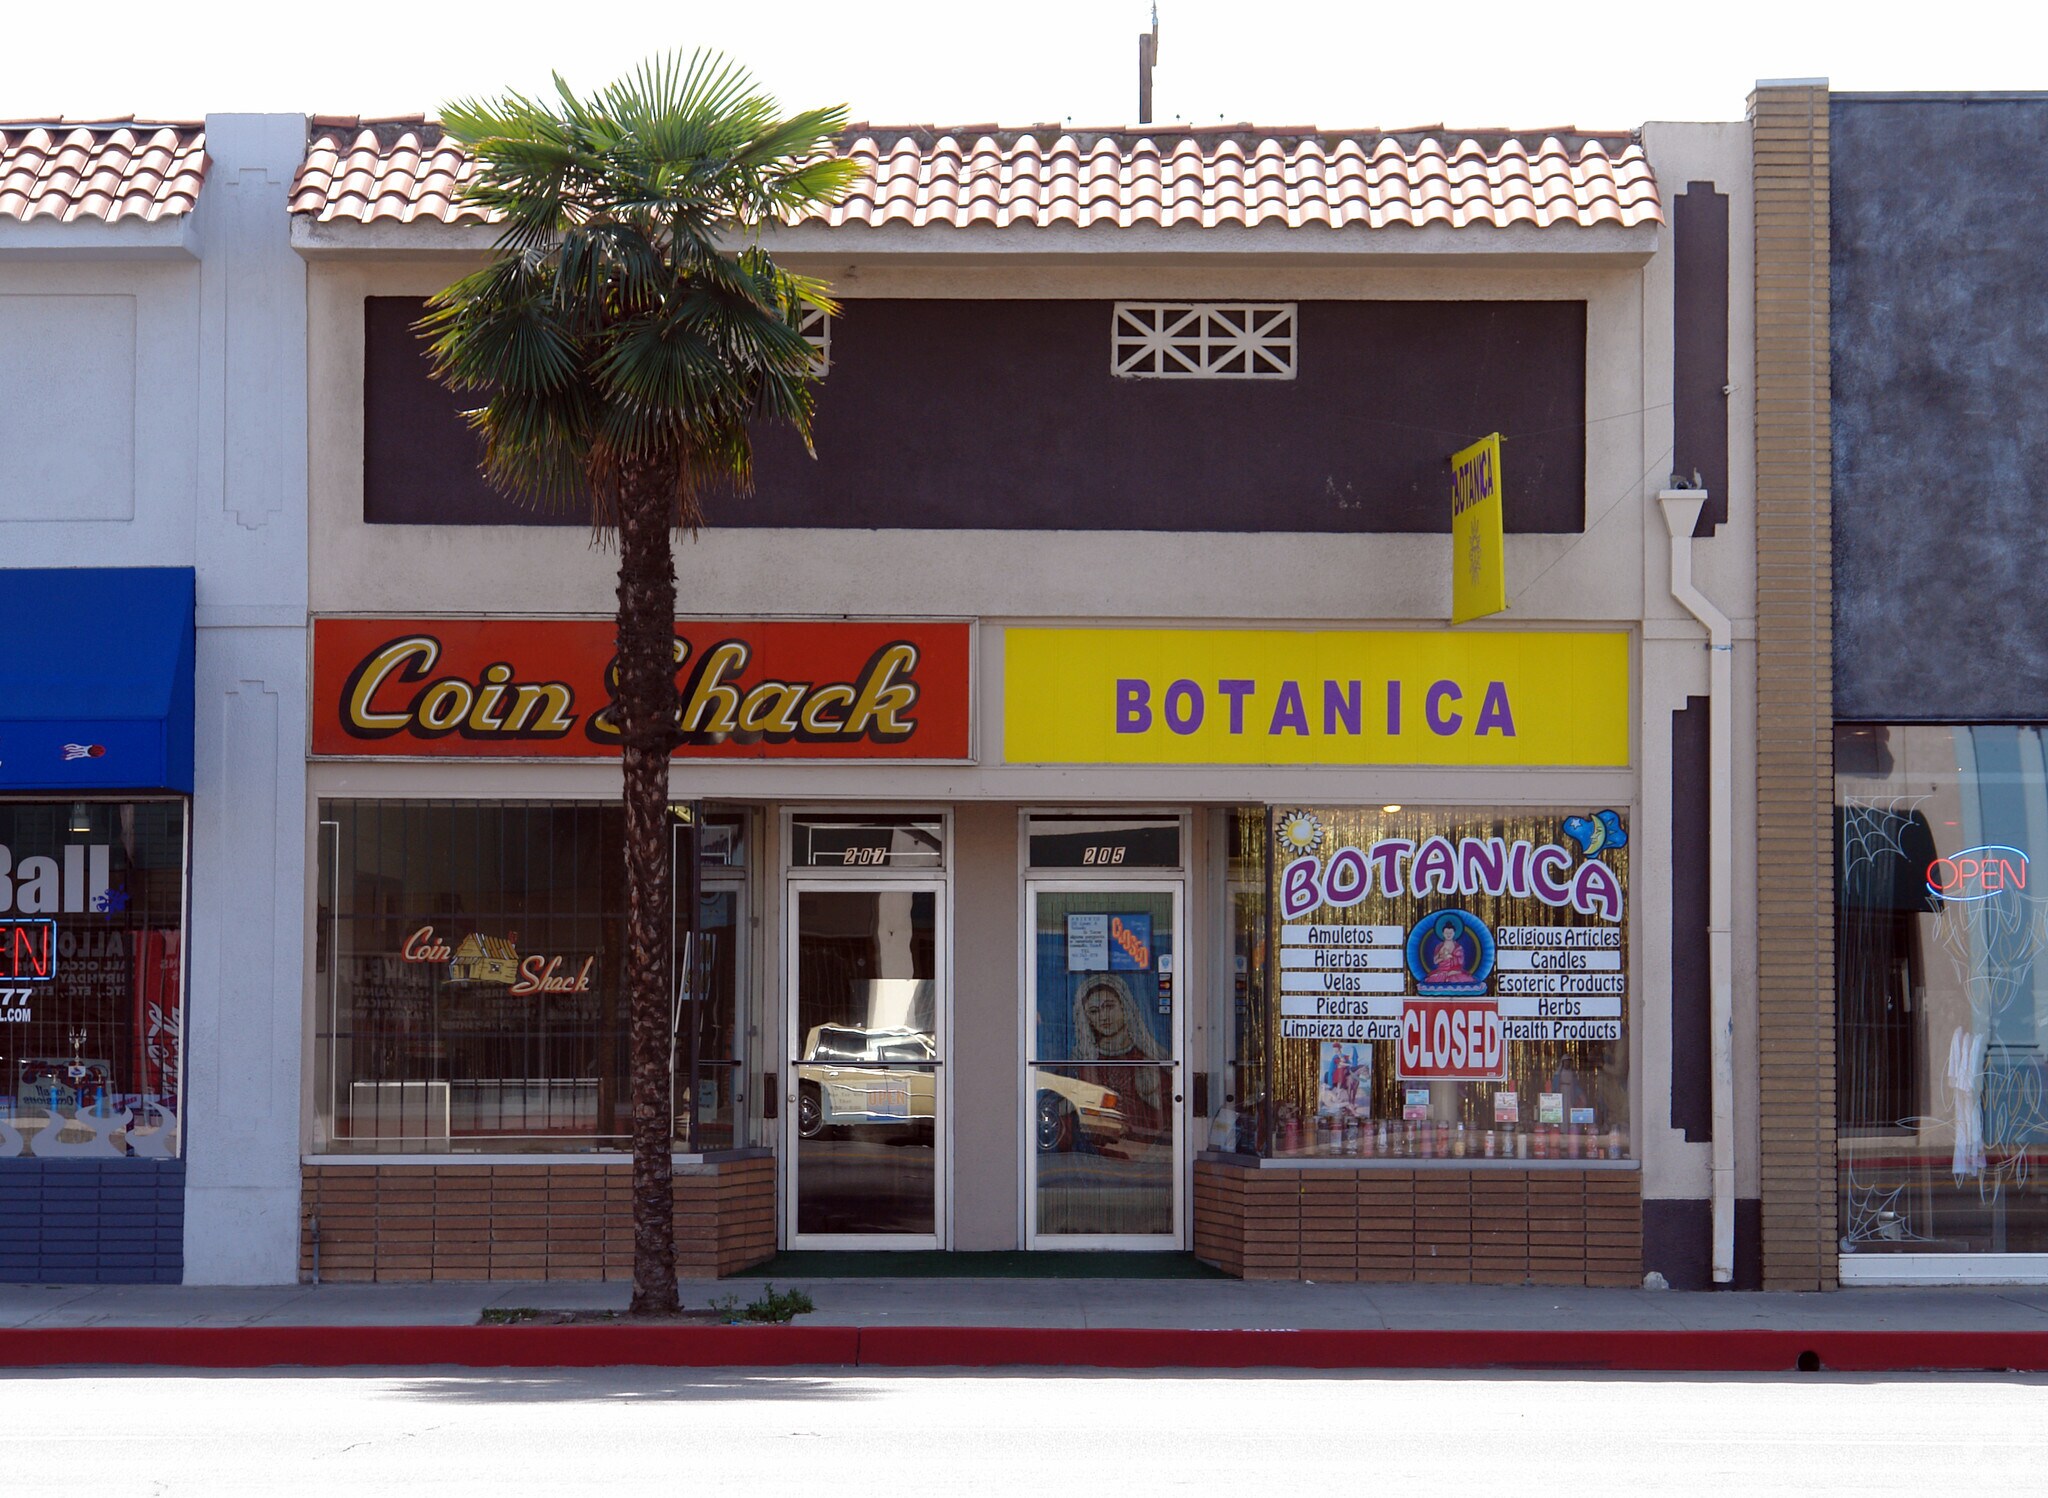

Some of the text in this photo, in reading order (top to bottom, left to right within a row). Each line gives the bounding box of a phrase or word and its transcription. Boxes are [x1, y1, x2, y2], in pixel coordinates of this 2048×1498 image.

[338, 634, 578, 739] Coin
[1115, 679, 1517, 737] BOTANICA
[844, 847, 886, 865] 207
[1083, 847, 1126, 864] 205
[1280, 836, 1623, 922] BOTANICA
[1926, 857, 2026, 890] OPEN
[401, 925, 451, 964] Coin
[1308, 926, 1373, 945] Amuletos
[1498, 927, 1620, 947] Religious Articles
[1314, 950, 1368, 968] Hierbas
[1531, 951, 1586, 969] Candles
[508, 954, 595, 996] Shack
[1324, 973, 1361, 991] Velas
[1498, 974, 1624, 992] Esoteric Products
[1316, 997, 1368, 1016] Piedras
[1538, 998, 1581, 1015] Herbs
[1283, 1019, 1401, 1039] Limpieza de Aura
[1403, 1008, 1501, 1069] CLOSED
[1502, 1020, 1617, 1040] Health Products
